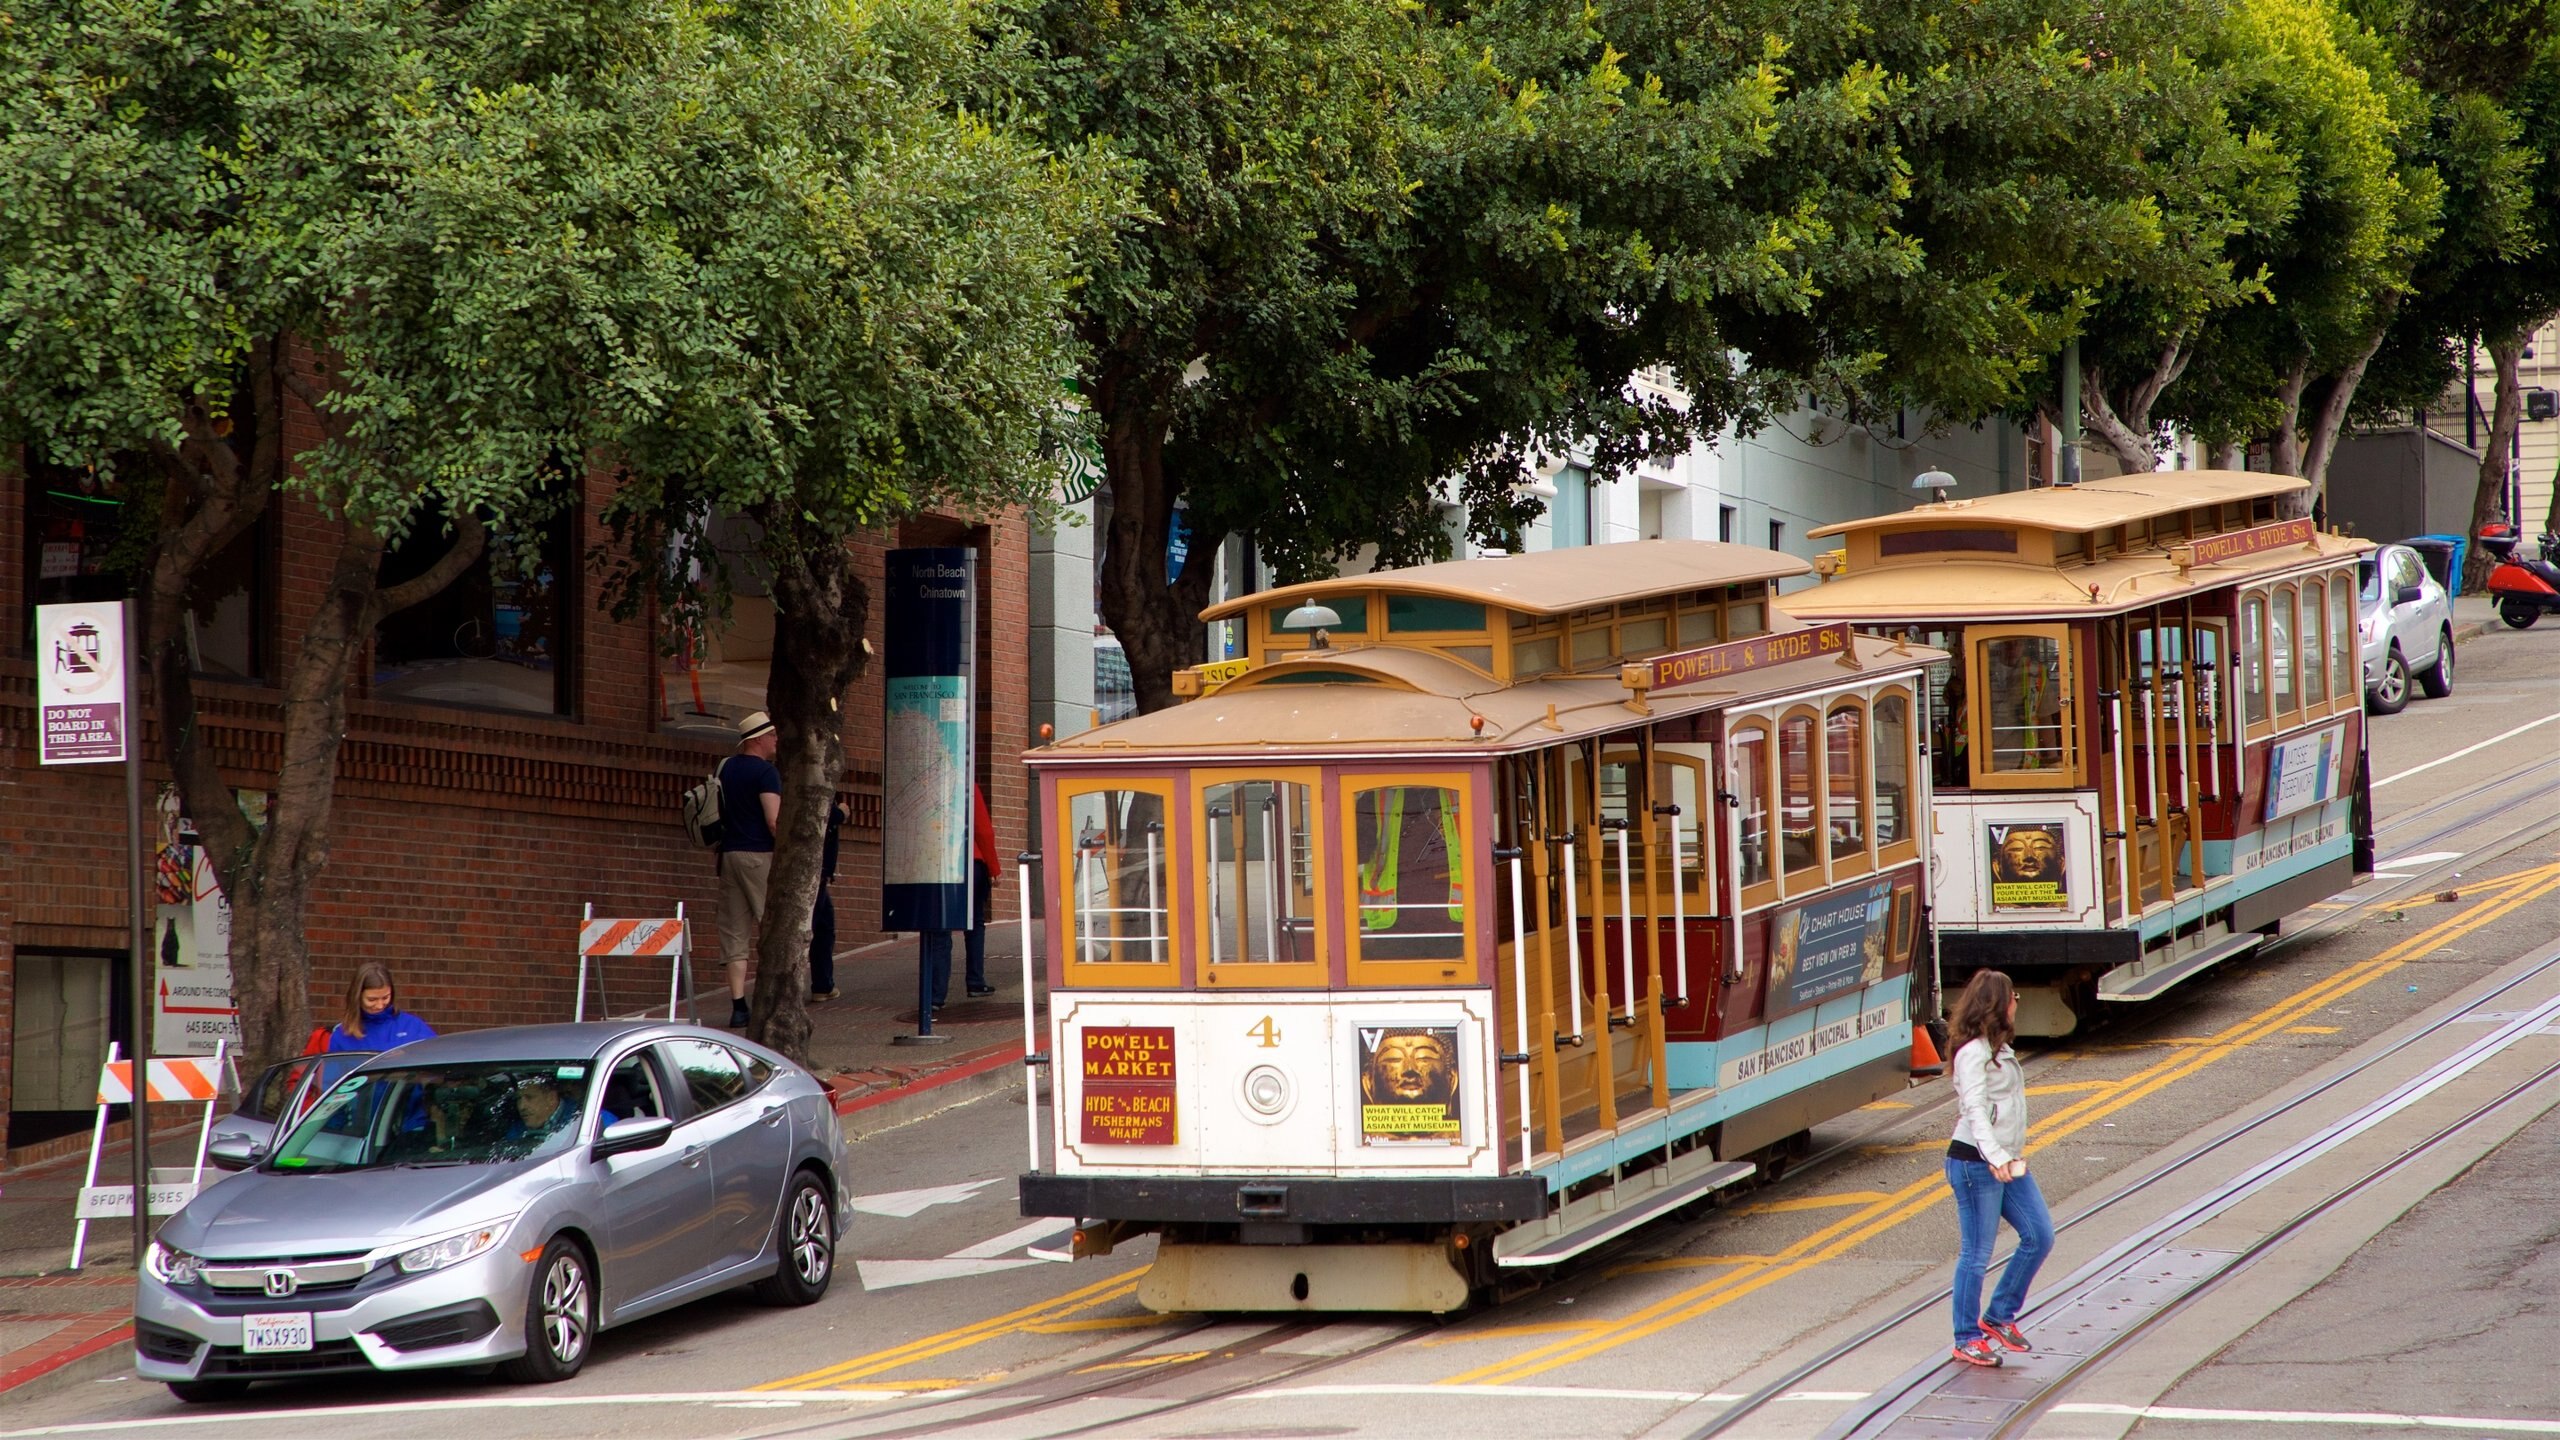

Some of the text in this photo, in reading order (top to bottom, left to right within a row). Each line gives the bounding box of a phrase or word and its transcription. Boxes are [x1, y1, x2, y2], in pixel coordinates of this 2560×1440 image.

[2197, 537, 2242, 561] POWELL
[2246, 534, 2255, 550] &
[2259, 527, 2288, 547] HYDE
[912, 563, 966, 578] North Beach
[920, 584, 966, 599] Chinatown
[1659, 630, 1842, 684] POWELL & HYDE Sts.
[894, 690, 955, 700] SAN FRANCISCO
[47, 708, 92, 720] DO NOT
[47, 719, 105, 732] BOARD IN
[47, 731, 113, 744] THIS AREA
[2246, 853, 2258, 870] SAN
[2289, 832, 2313, 853] MNICIPAL
[2315, 823, 2335, 843] RILWAY
[1811, 911, 1838, 933] CHART
[1839, 903, 1866, 922] HOUSE
[1802, 942, 1857, 973] BEST VIEW ON PIER 39
[172, 986, 201, 997] AROUND
[202, 987, 213, 997] THE
[186, 1021, 200, 1034] 645
[202, 1021, 228, 1034] BEACH
[1246, 1015, 1282, 1048] 4
[1086, 1034, 1169, 1050] POWELL
[1109, 1050, 1151, 1061] AND
[1738, 1058, 1756, 1081] SAN
[1758, 1038, 1805, 1072] FRANCISCO
[1086, 1062, 1172, 1076] MARKET
[1085, 1096, 1114, 1112] HYDE
[1132, 1096, 1170, 1113] BEACH
[1092, 1115, 1163, 1128] FISHERMANS
[1109, 1128, 1145, 1139] WHARF
[248, 1327, 307, 1347] 7WSX930
